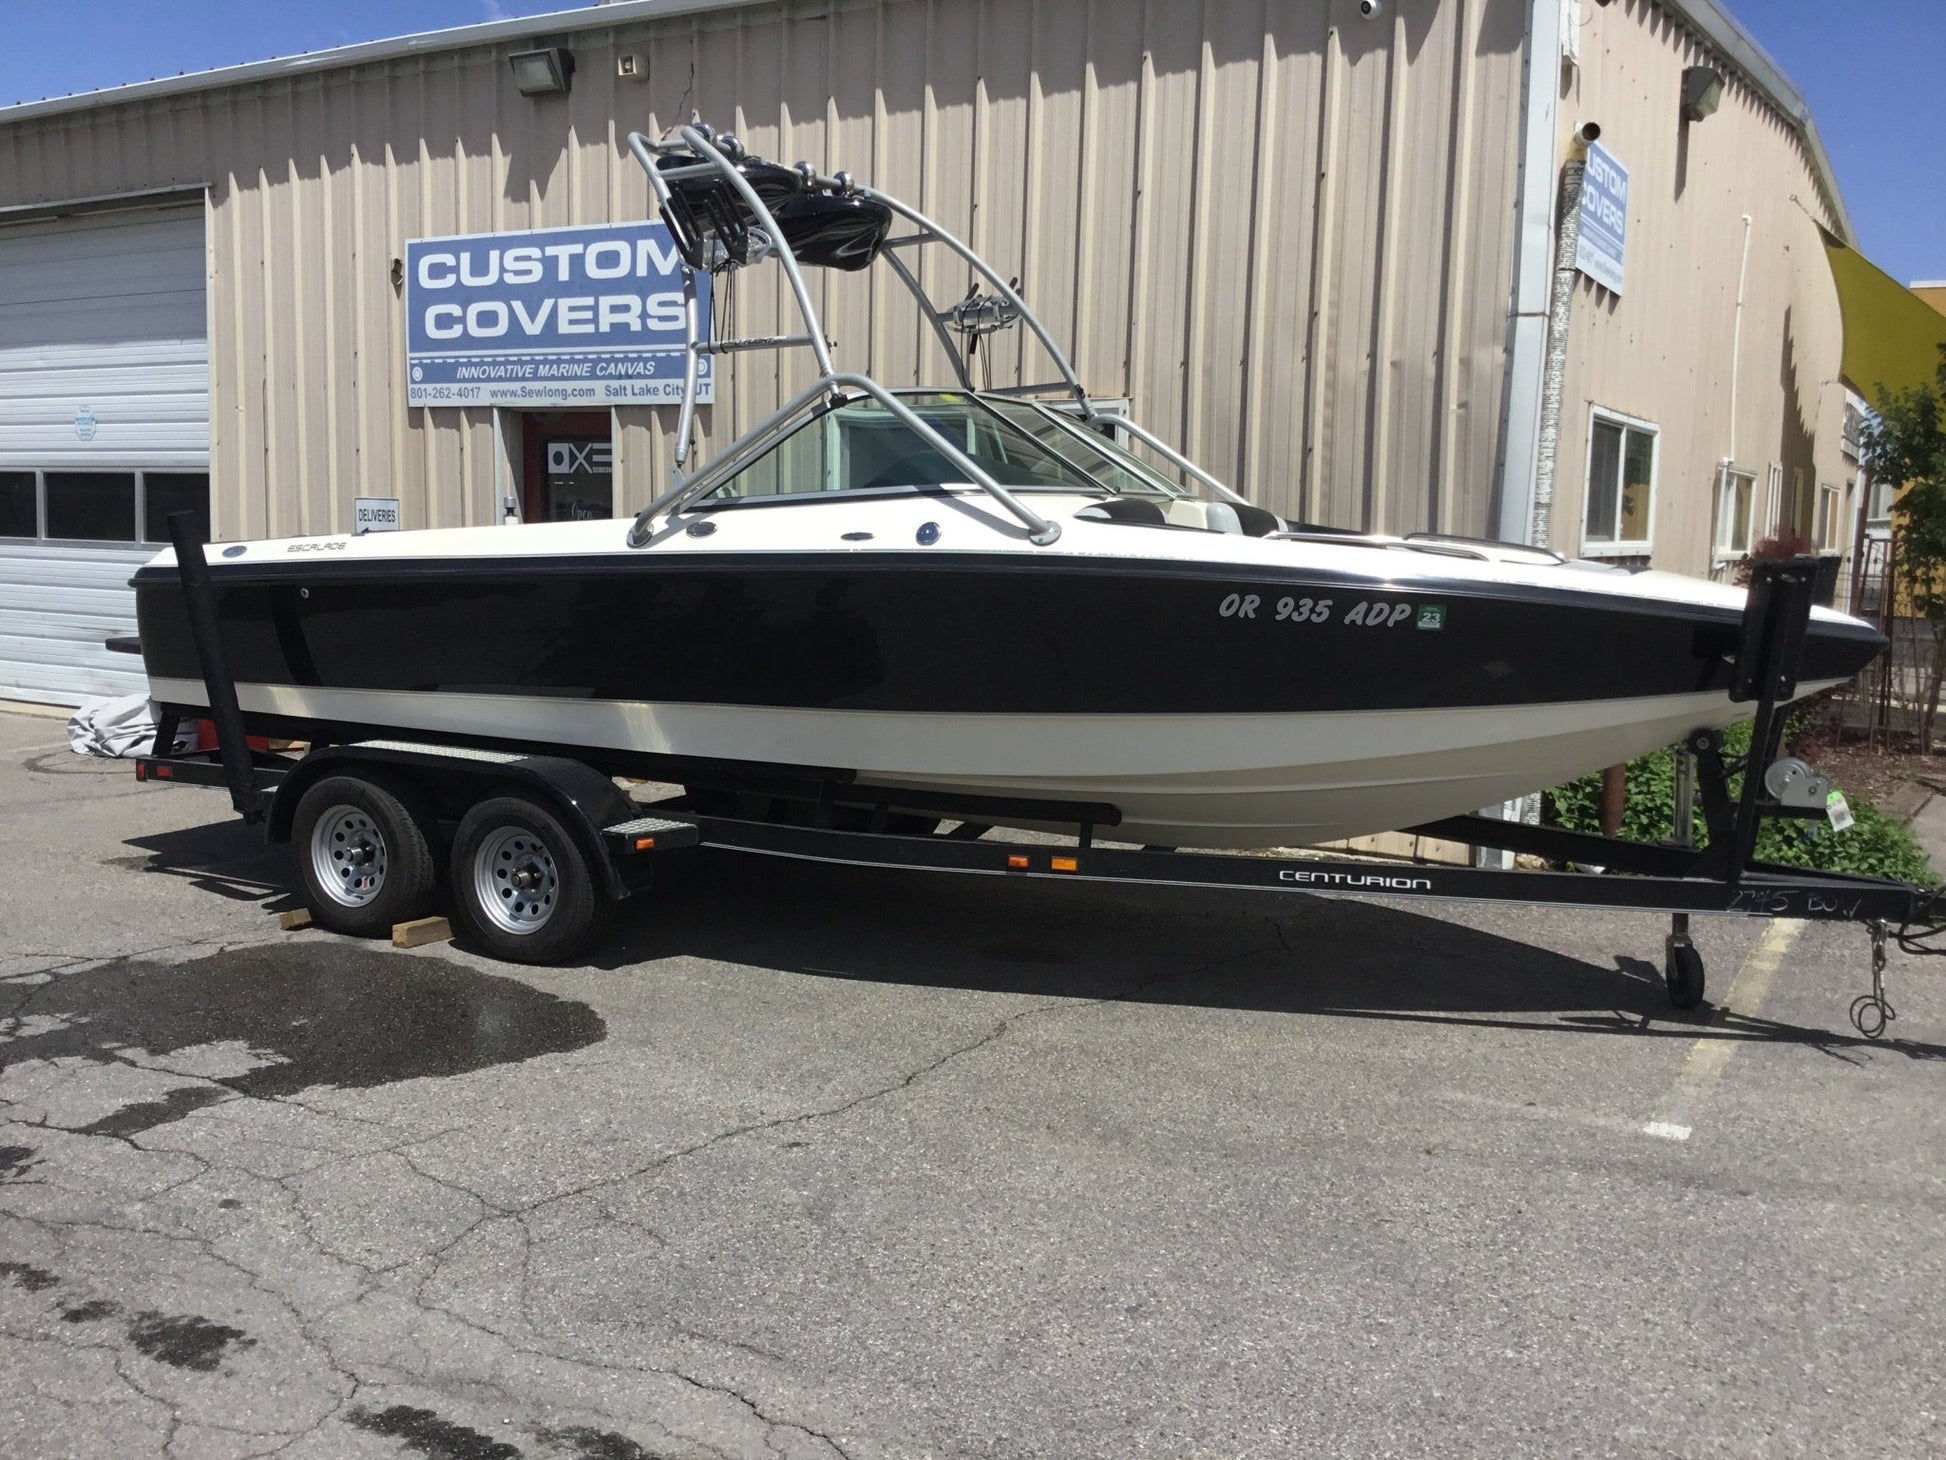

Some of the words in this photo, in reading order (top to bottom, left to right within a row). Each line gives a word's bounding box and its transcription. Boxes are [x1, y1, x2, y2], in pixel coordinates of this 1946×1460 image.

[1587, 149, 1626, 204] USTOM
[418, 239, 679, 289] CUSTOM
[425, 292, 686, 339] COVERS
[456, 365, 535, 379] INNOVATIVE
[537, 363, 592, 378] MARINE
[596, 361, 655, 376] CANVAS
[410, 386, 481, 399] 801-262-4017
[490, 385, 596, 400] www.Sewlong.com
[604, 384, 628, 397] Salt
[631, 383, 659, 397] Lake
[358, 508, 396, 523] DELIVERIES
[287, 542, 347, 553] ESCALADE
[1219, 593, 1261, 618] OR
[1275, 597, 1333, 623] 935
[1343, 601, 1411, 627] ADP
[1422, 612, 1440, 623] 23
[1279, 870, 1431, 889] CENTURION
